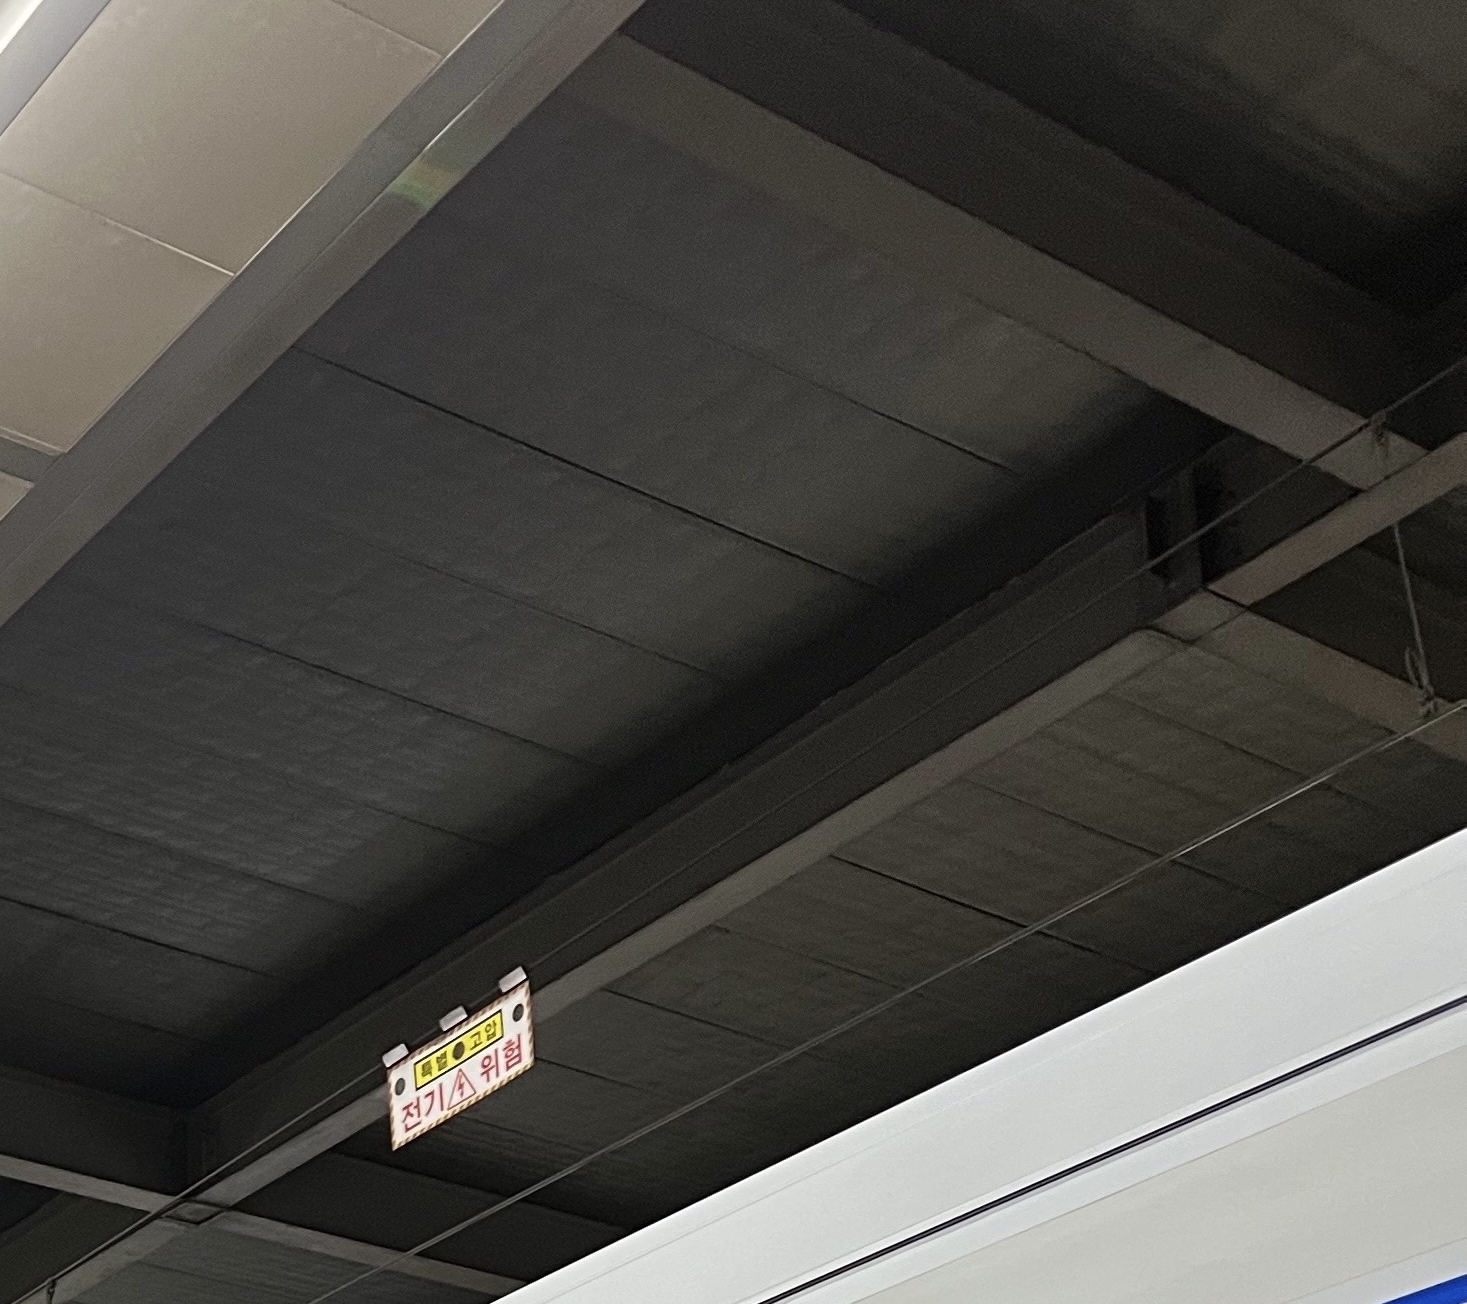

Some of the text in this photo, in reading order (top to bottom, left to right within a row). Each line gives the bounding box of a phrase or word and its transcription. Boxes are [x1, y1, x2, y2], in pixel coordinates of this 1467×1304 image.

[401, 1033, 522, 1133] 전기 위험
[420, 1019, 497, 1078] 특별 고압
